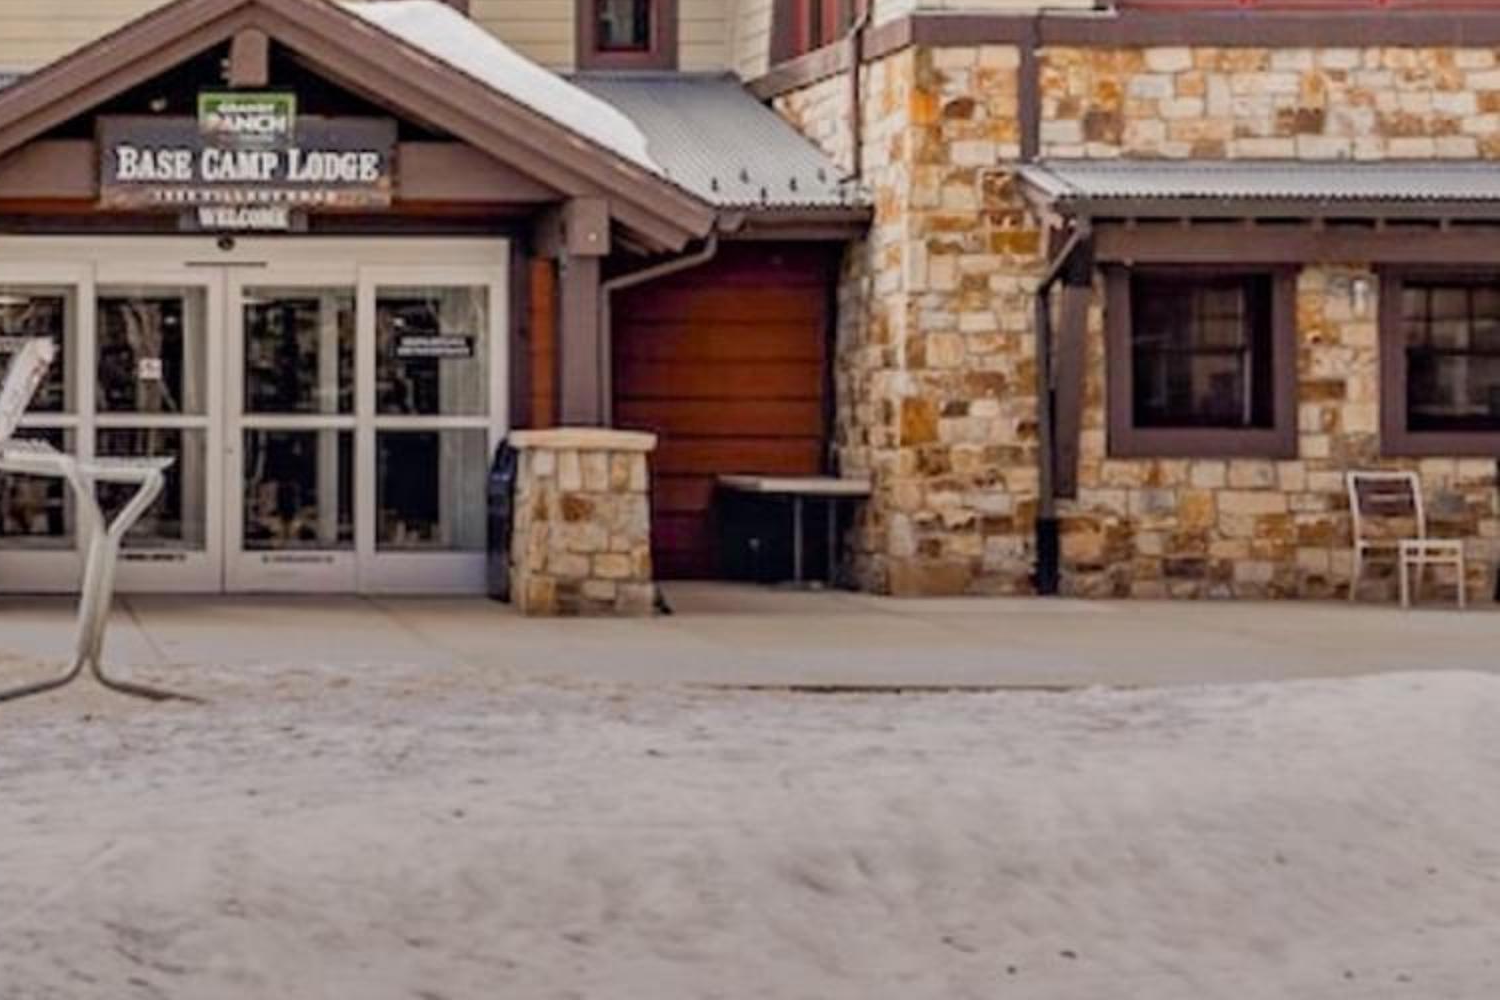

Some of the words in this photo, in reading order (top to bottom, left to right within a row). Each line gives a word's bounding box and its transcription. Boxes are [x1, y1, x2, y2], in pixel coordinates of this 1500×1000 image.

[116, 146, 192, 181] BASE
[201, 148, 278, 181] CAMP
[287, 147, 380, 182] LODGE
[199, 205, 290, 229] WELCOME
